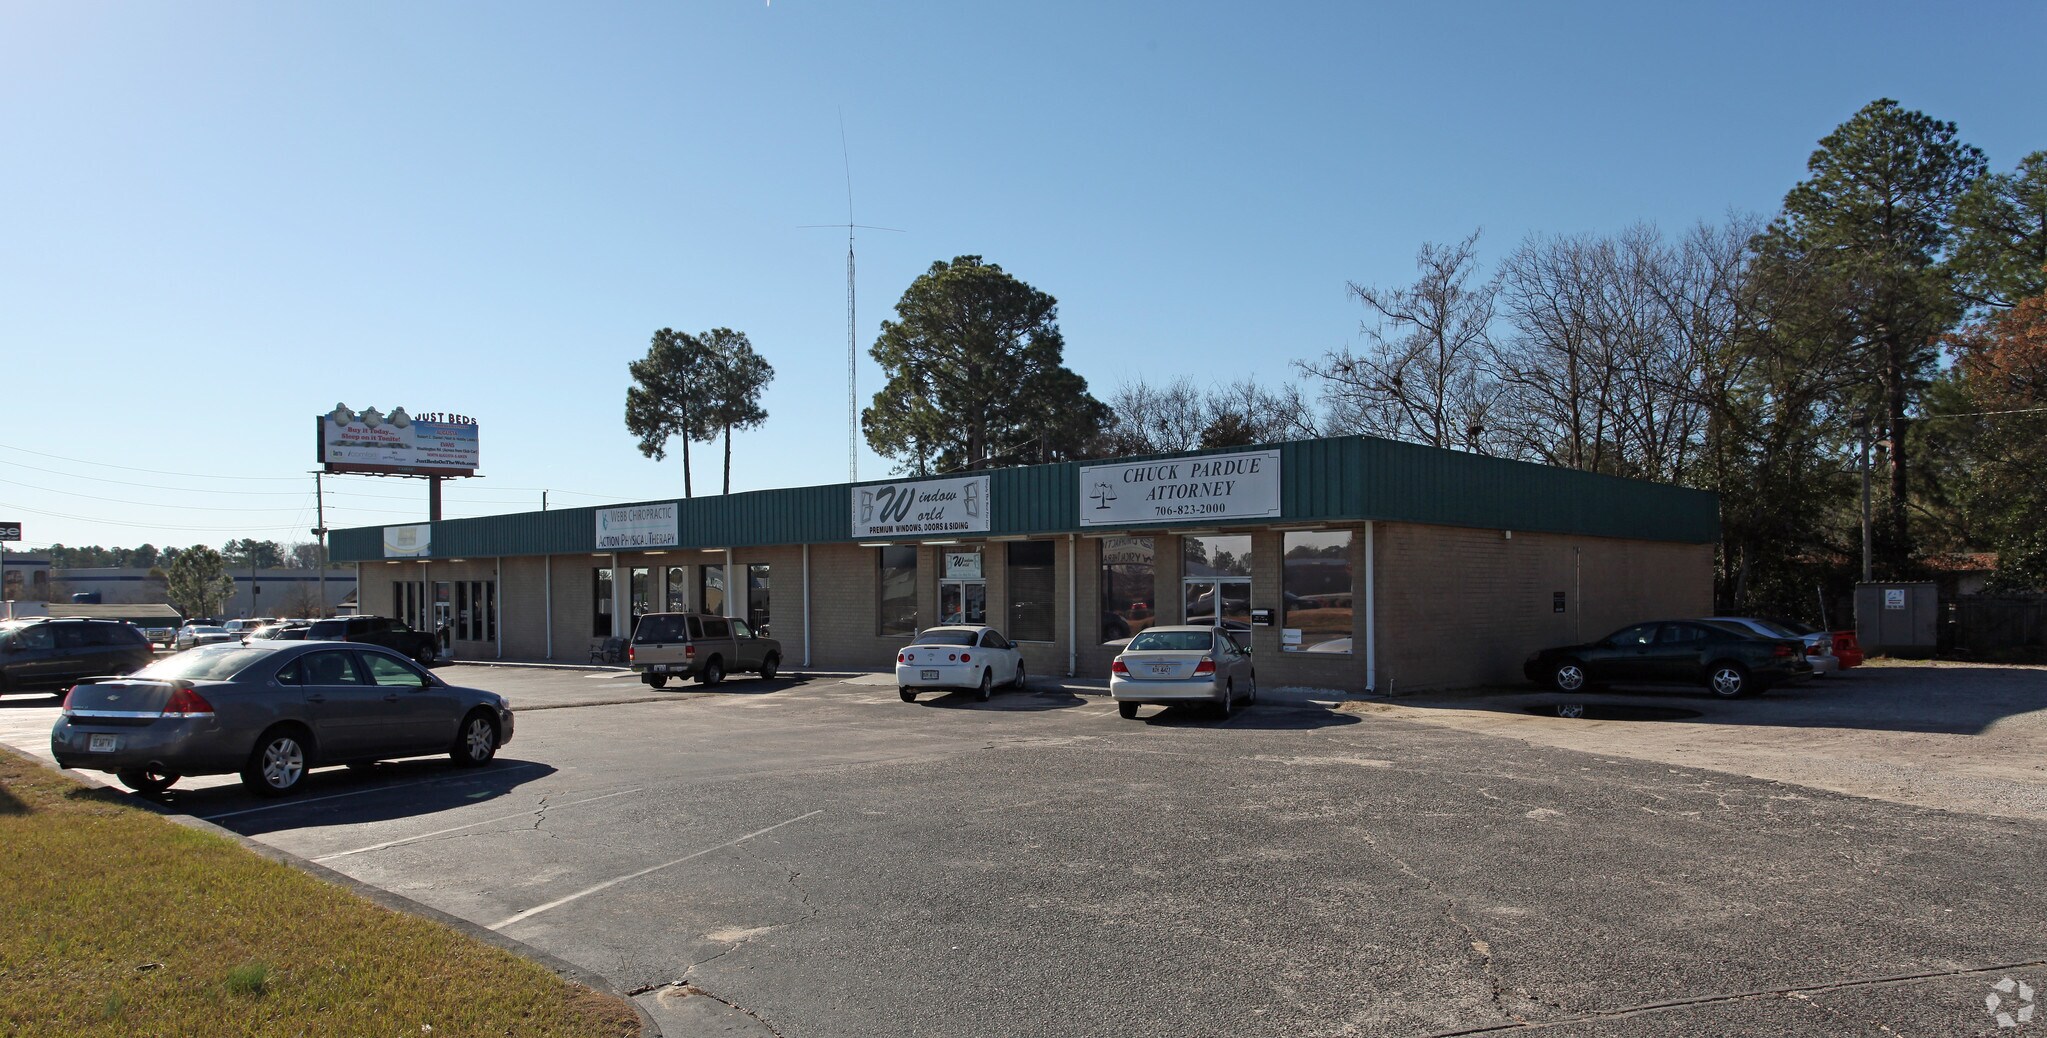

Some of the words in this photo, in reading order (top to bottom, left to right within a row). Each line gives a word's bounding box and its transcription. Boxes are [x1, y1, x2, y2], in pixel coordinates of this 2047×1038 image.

[415, 412, 444, 422] JUST
[448, 413, 477, 425] BEDS
[347, 426, 361, 434] Buy
[341, 433, 360, 441] Sleep
[1123, 465, 1180, 483] CHUCK
[1190, 458, 1262, 478] PARDUE
[1146, 480, 1236, 501] ATTORNEY
[610, 510, 628, 523] WEBB
[628, 507, 672, 522] CHIROPRACTIC
[1155, 503, 1226, 516] 706-823-2000
[869, 525, 894, 534] PREMIUM
[895, 523, 923, 533] WINDOWS,
[924, 522, 943, 531] DOORS
[944, 522, 948, 530] &
[949, 521, 969, 530] SIDING
[598, 535, 620, 547] ACTION
[620, 533, 648, 546] PHYSICAL
[648, 532, 675, 545] THERAPY
